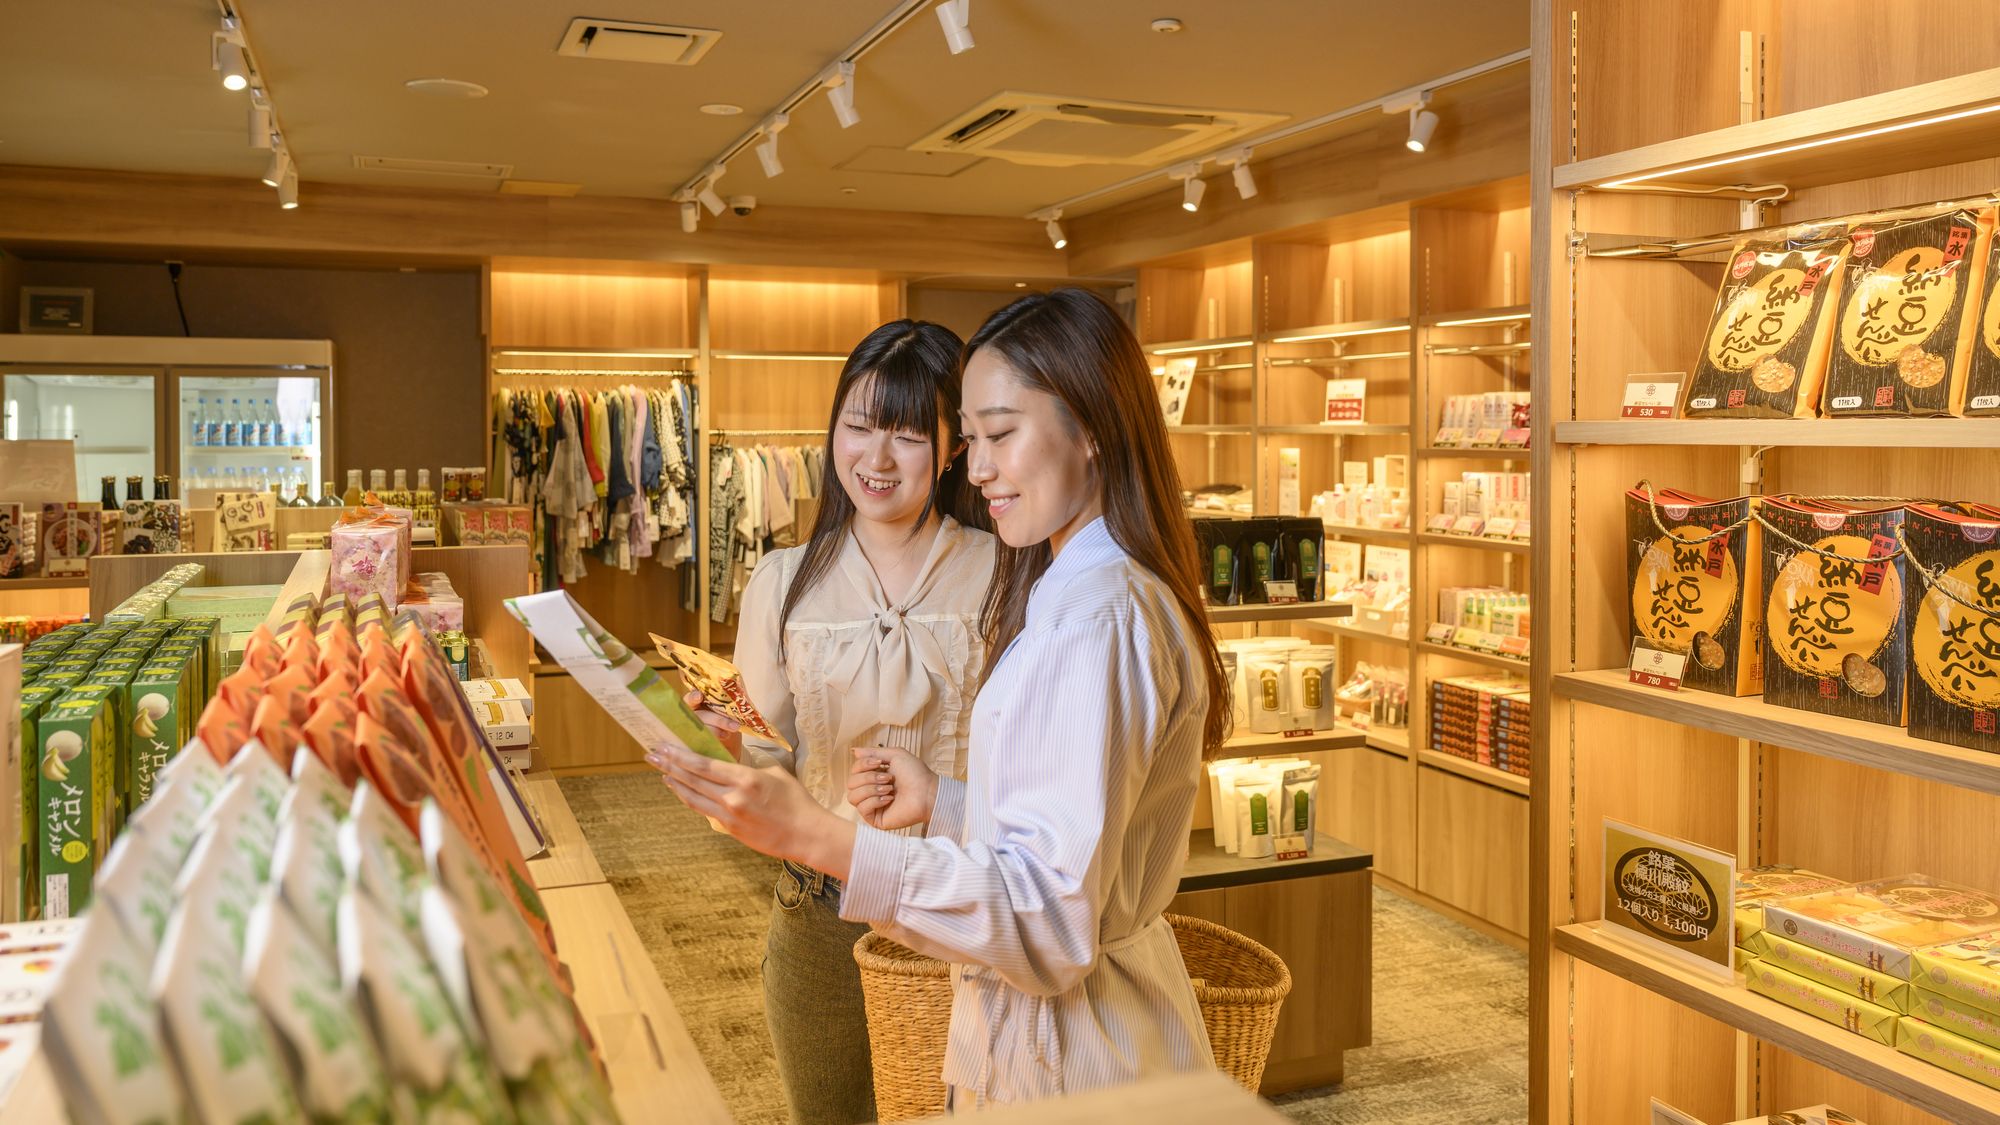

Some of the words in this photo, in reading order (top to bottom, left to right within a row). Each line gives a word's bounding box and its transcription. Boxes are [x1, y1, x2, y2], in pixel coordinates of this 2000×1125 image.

[1639, 408, 1654, 417] 530
[1707, 540, 1725, 574] 水戸
[1787, 595, 1838, 664] せんべい
[1939, 615, 1998, 692] せんべい
[1647, 676, 1661, 686] 780
[505, 731, 514, 740] 04
[503, 756, 512, 765] 04
[47, 796, 63, 857] キャラメル
[60, 781, 84, 839] メロン
[1647, 849, 1676, 873] 銘菓
[1616, 896, 1660, 923] 12個入り
[1662, 914, 1709, 942] 1,100円
